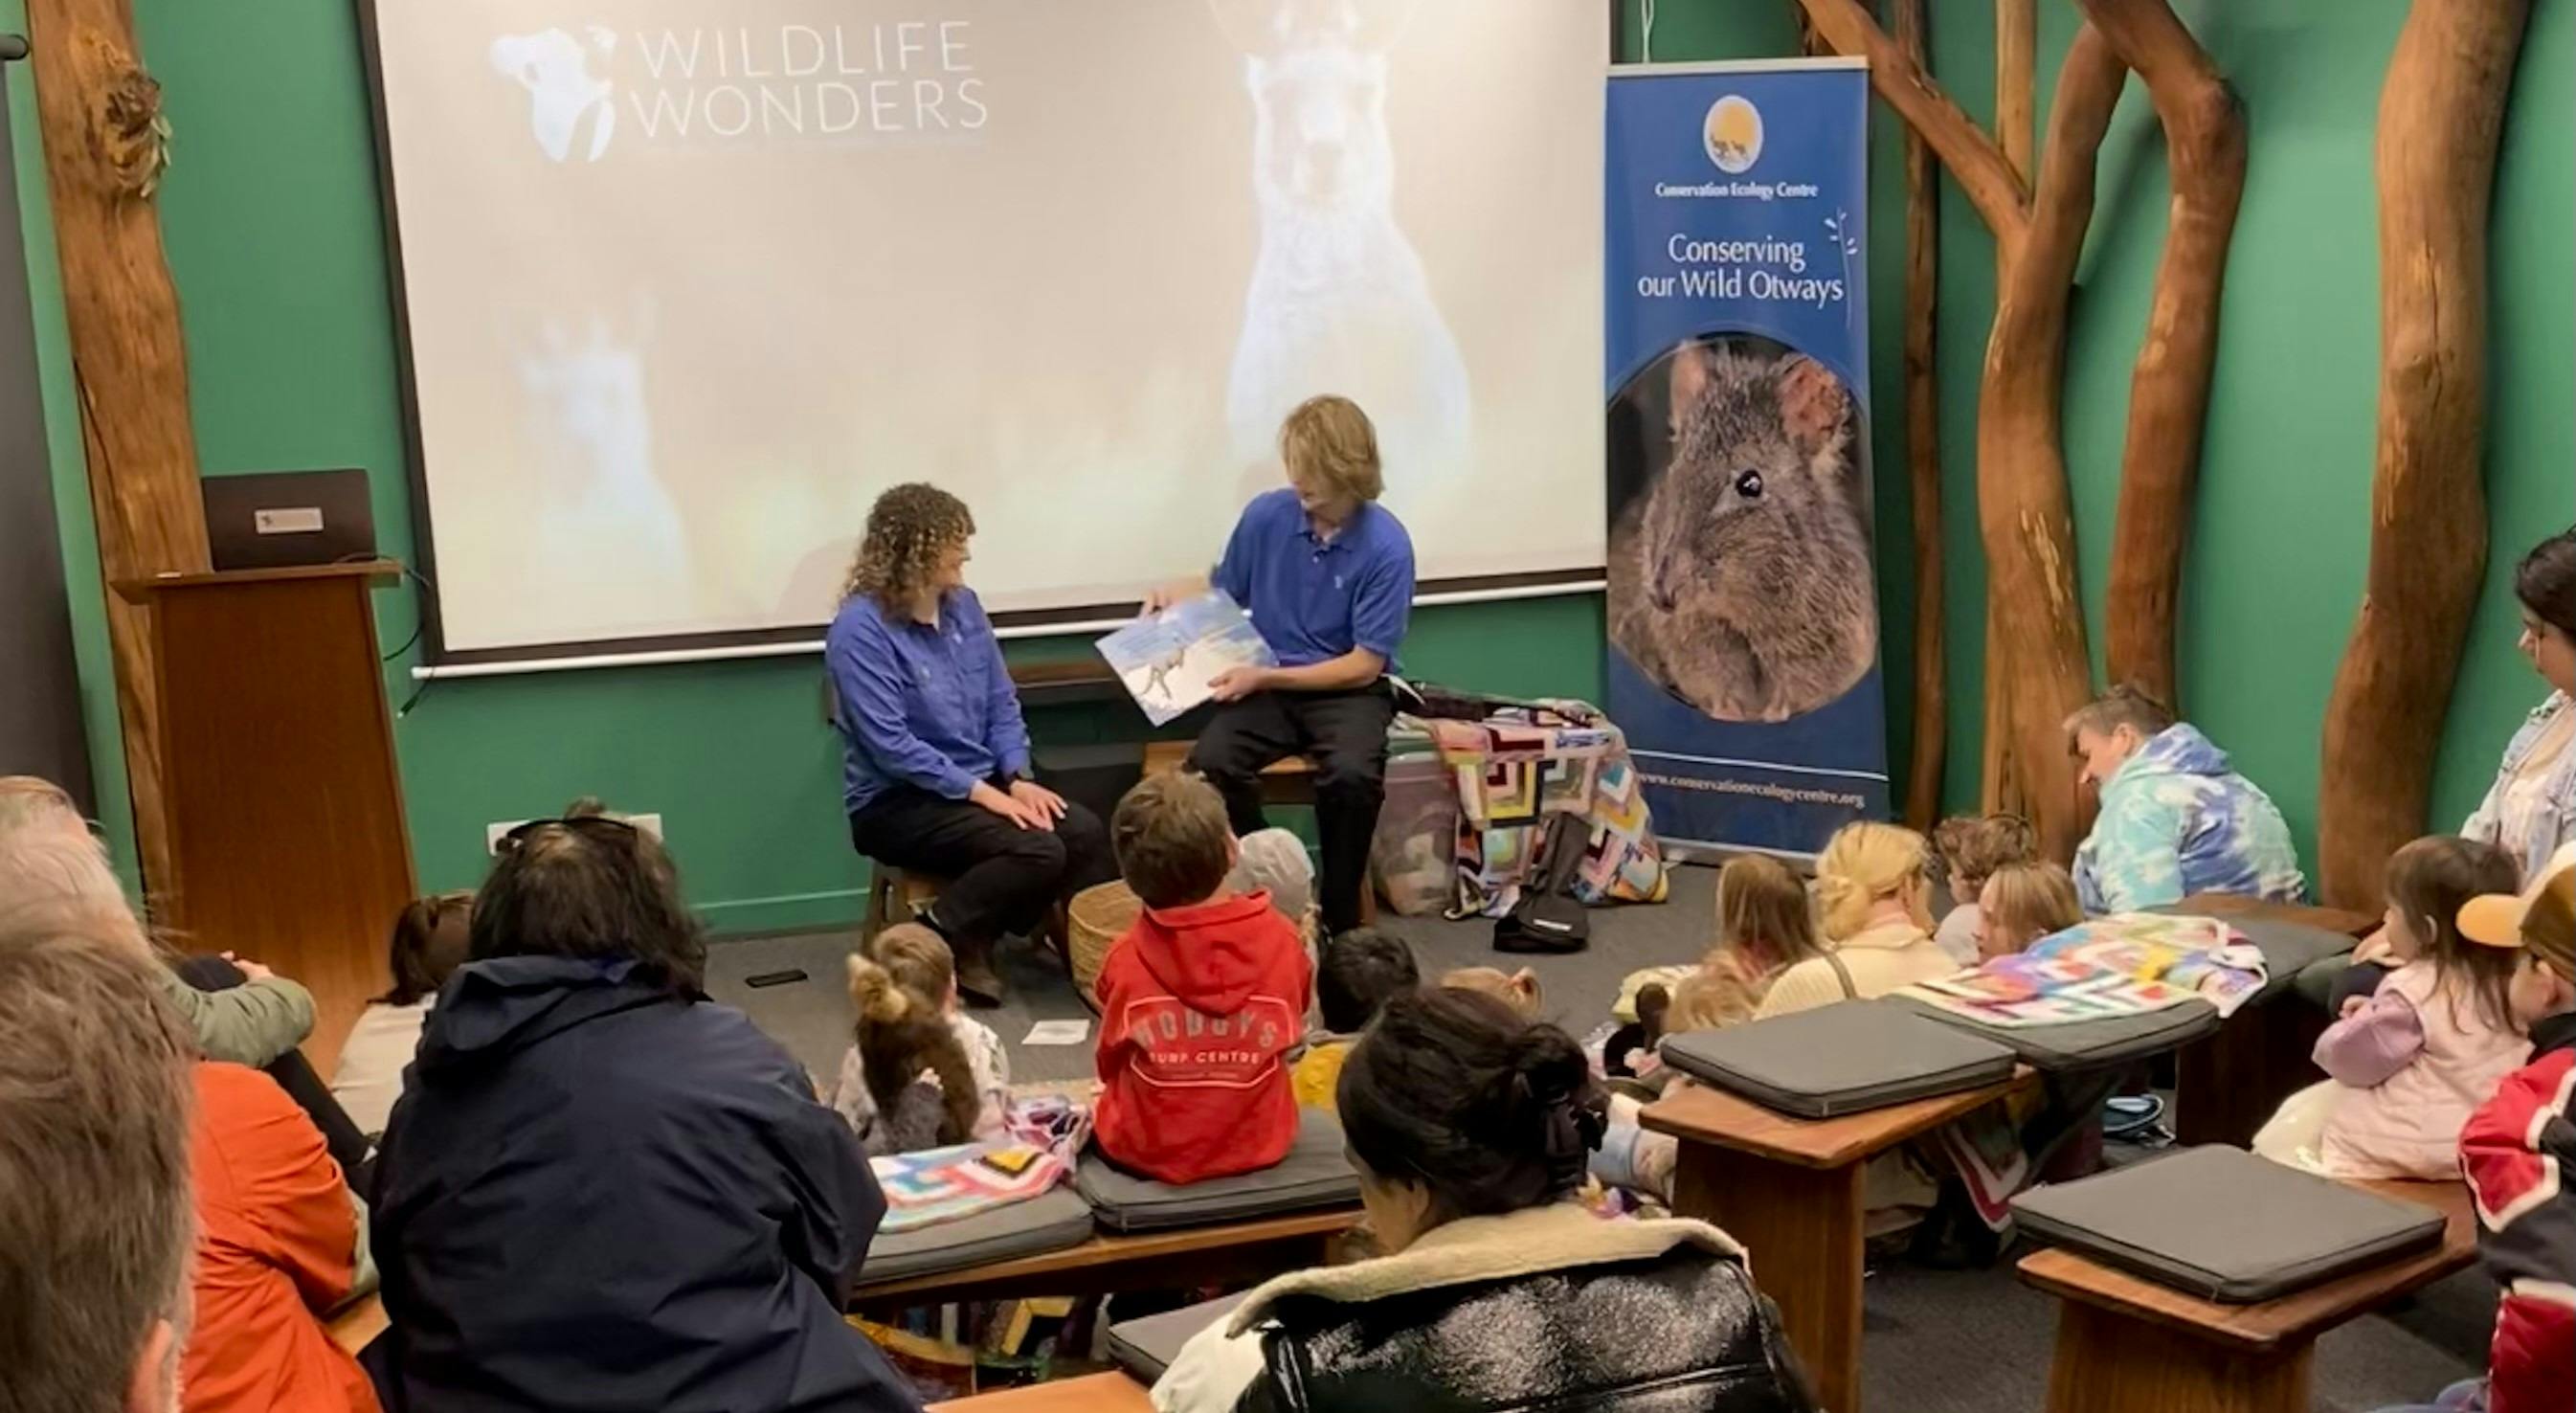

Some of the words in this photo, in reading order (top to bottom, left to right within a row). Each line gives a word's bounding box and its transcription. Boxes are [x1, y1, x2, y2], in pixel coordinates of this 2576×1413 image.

[636, 20, 974, 79] WILDLIFE
[630, 78, 988, 139] WONDERS
[1654, 182, 1729, 198] Conservation
[1730, 182, 1775, 201] Ecology
[1776, 181, 1819, 197] Centre
[1668, 234, 1805, 273] Conserving
[1637, 275, 1676, 298] our
[1681, 268, 1742, 299] Wild
[1749, 270, 1844, 310] Otways
